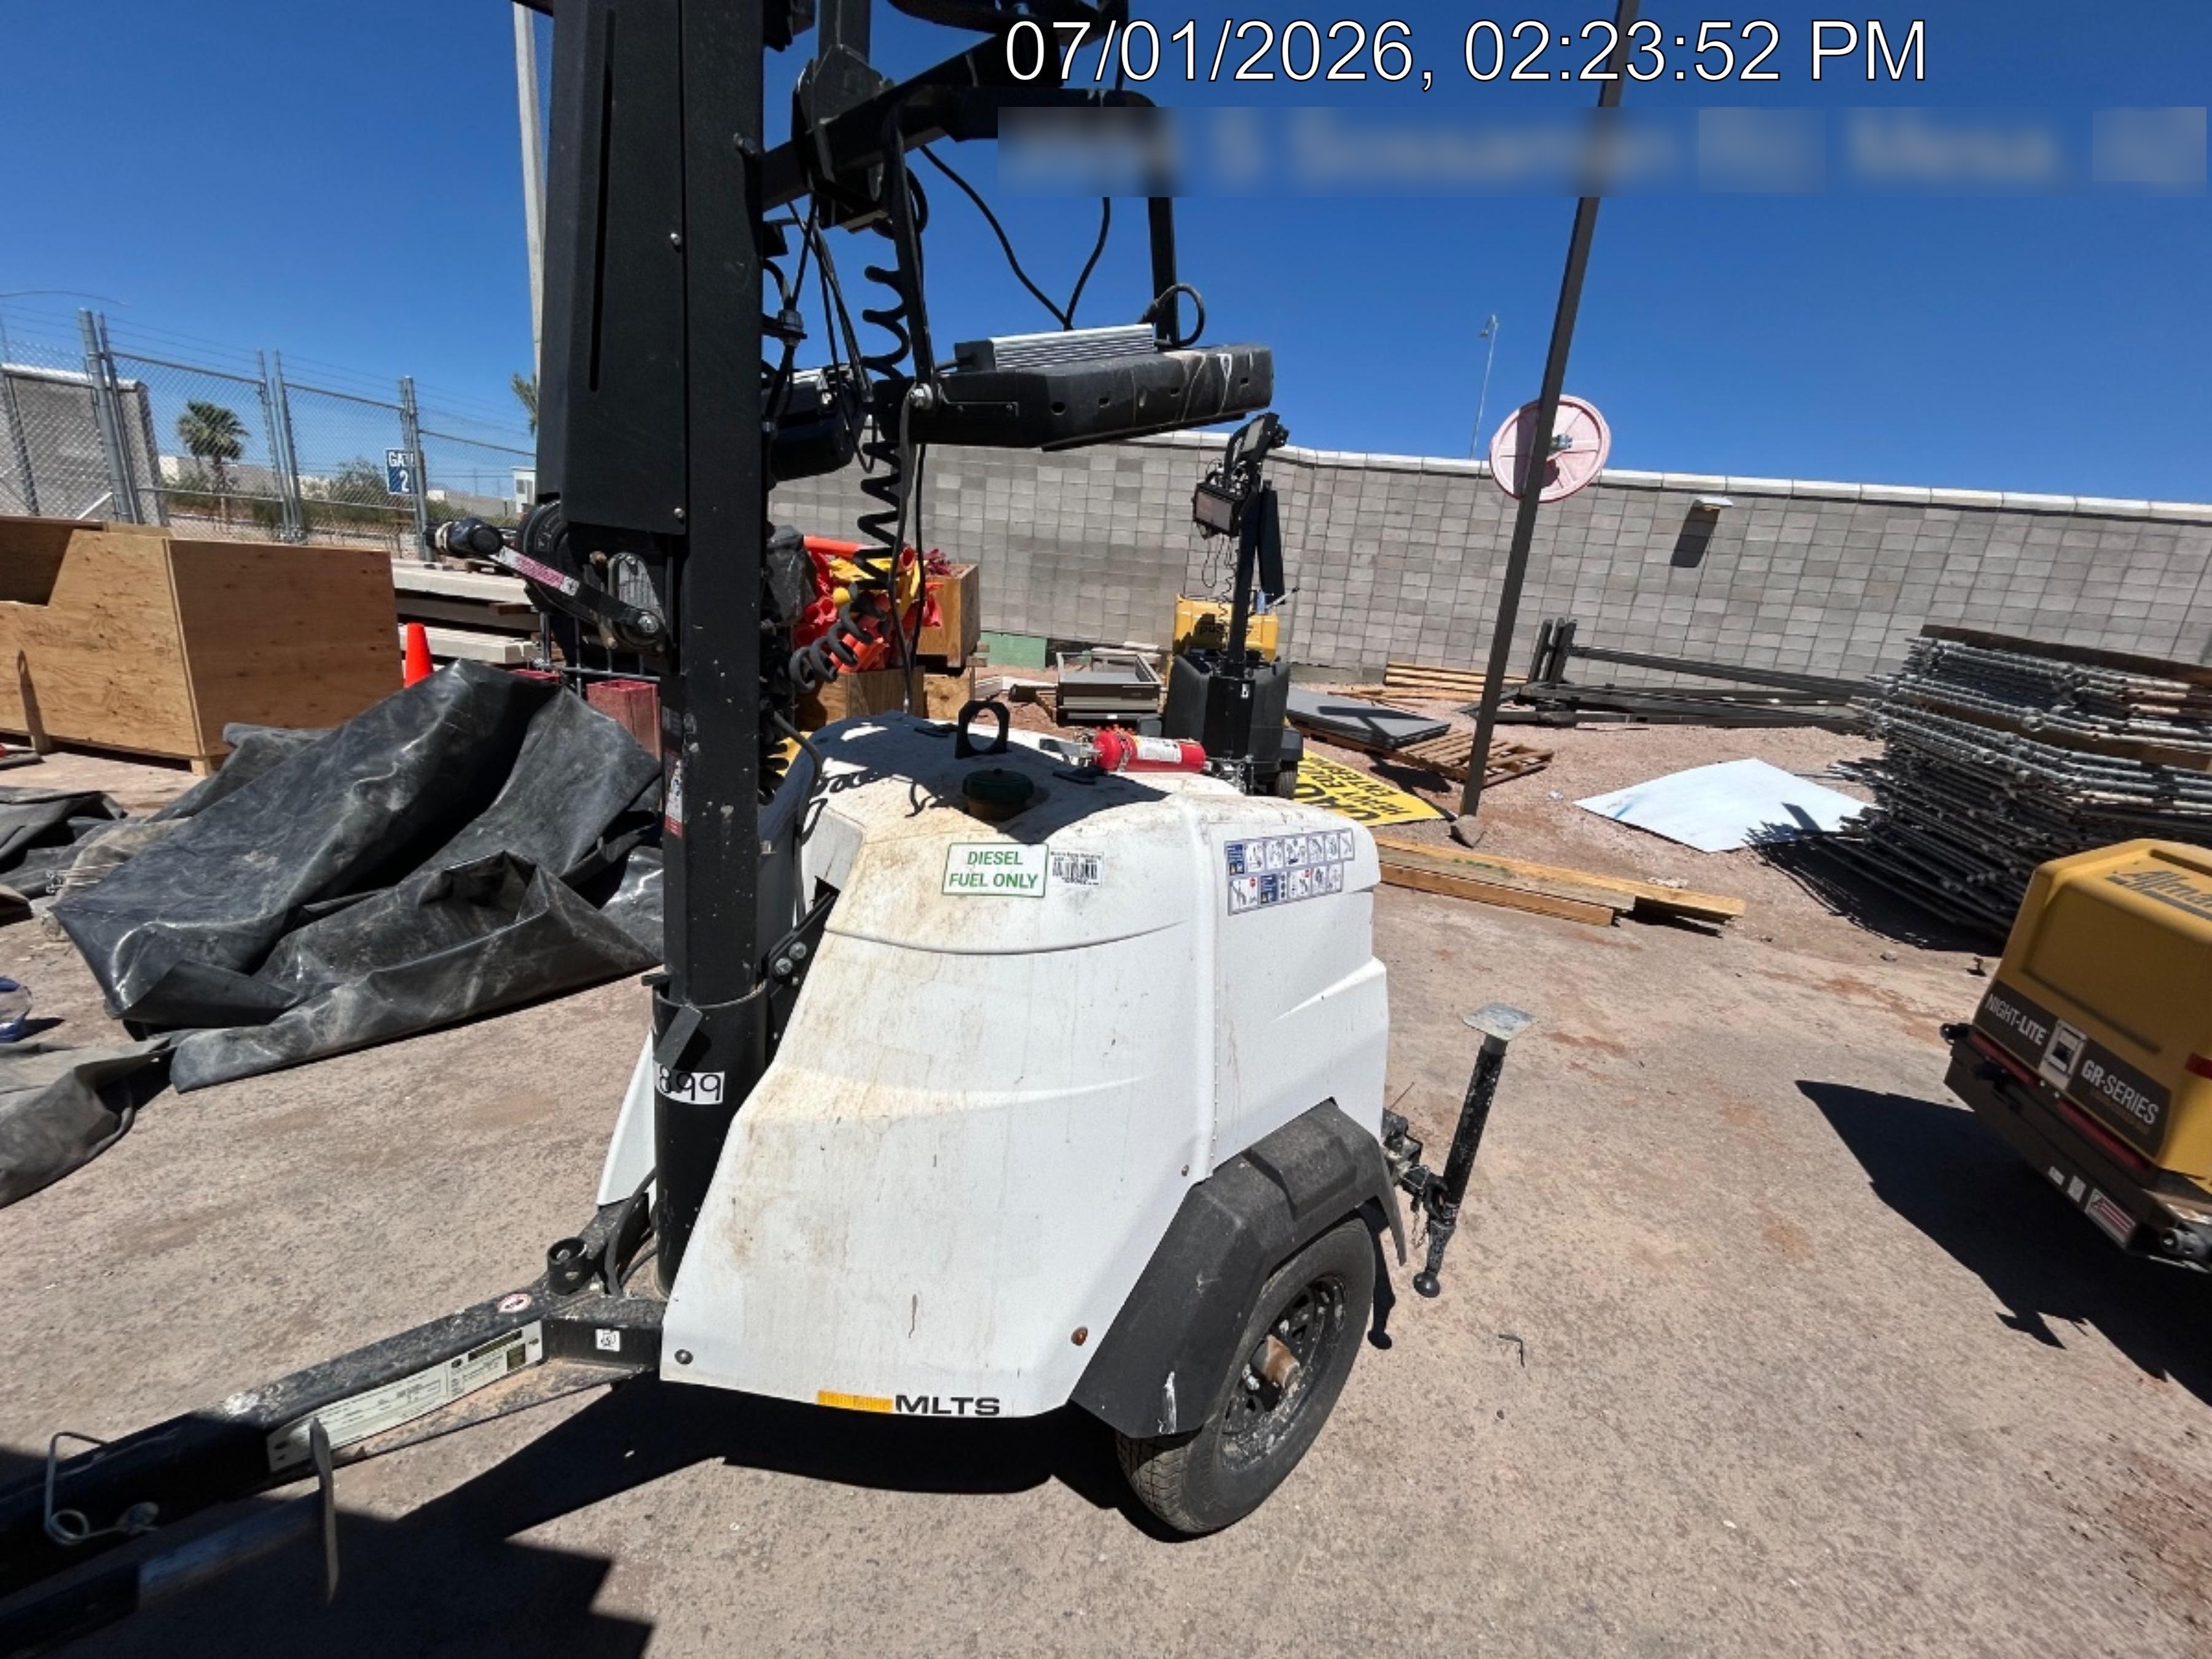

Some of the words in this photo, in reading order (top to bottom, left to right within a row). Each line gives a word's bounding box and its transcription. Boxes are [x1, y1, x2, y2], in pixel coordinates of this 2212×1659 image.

[389, 452, 415, 466] GA
[399, 469, 410, 492] 2
[967, 851, 1024, 866] DIESEL
[949, 873, 989, 888] FUEL
[993, 873, 1039, 889] ONLY
[2081, 1059, 2160, 1126] GR-SERIES
[895, 1394, 1000, 1416] MLTS
